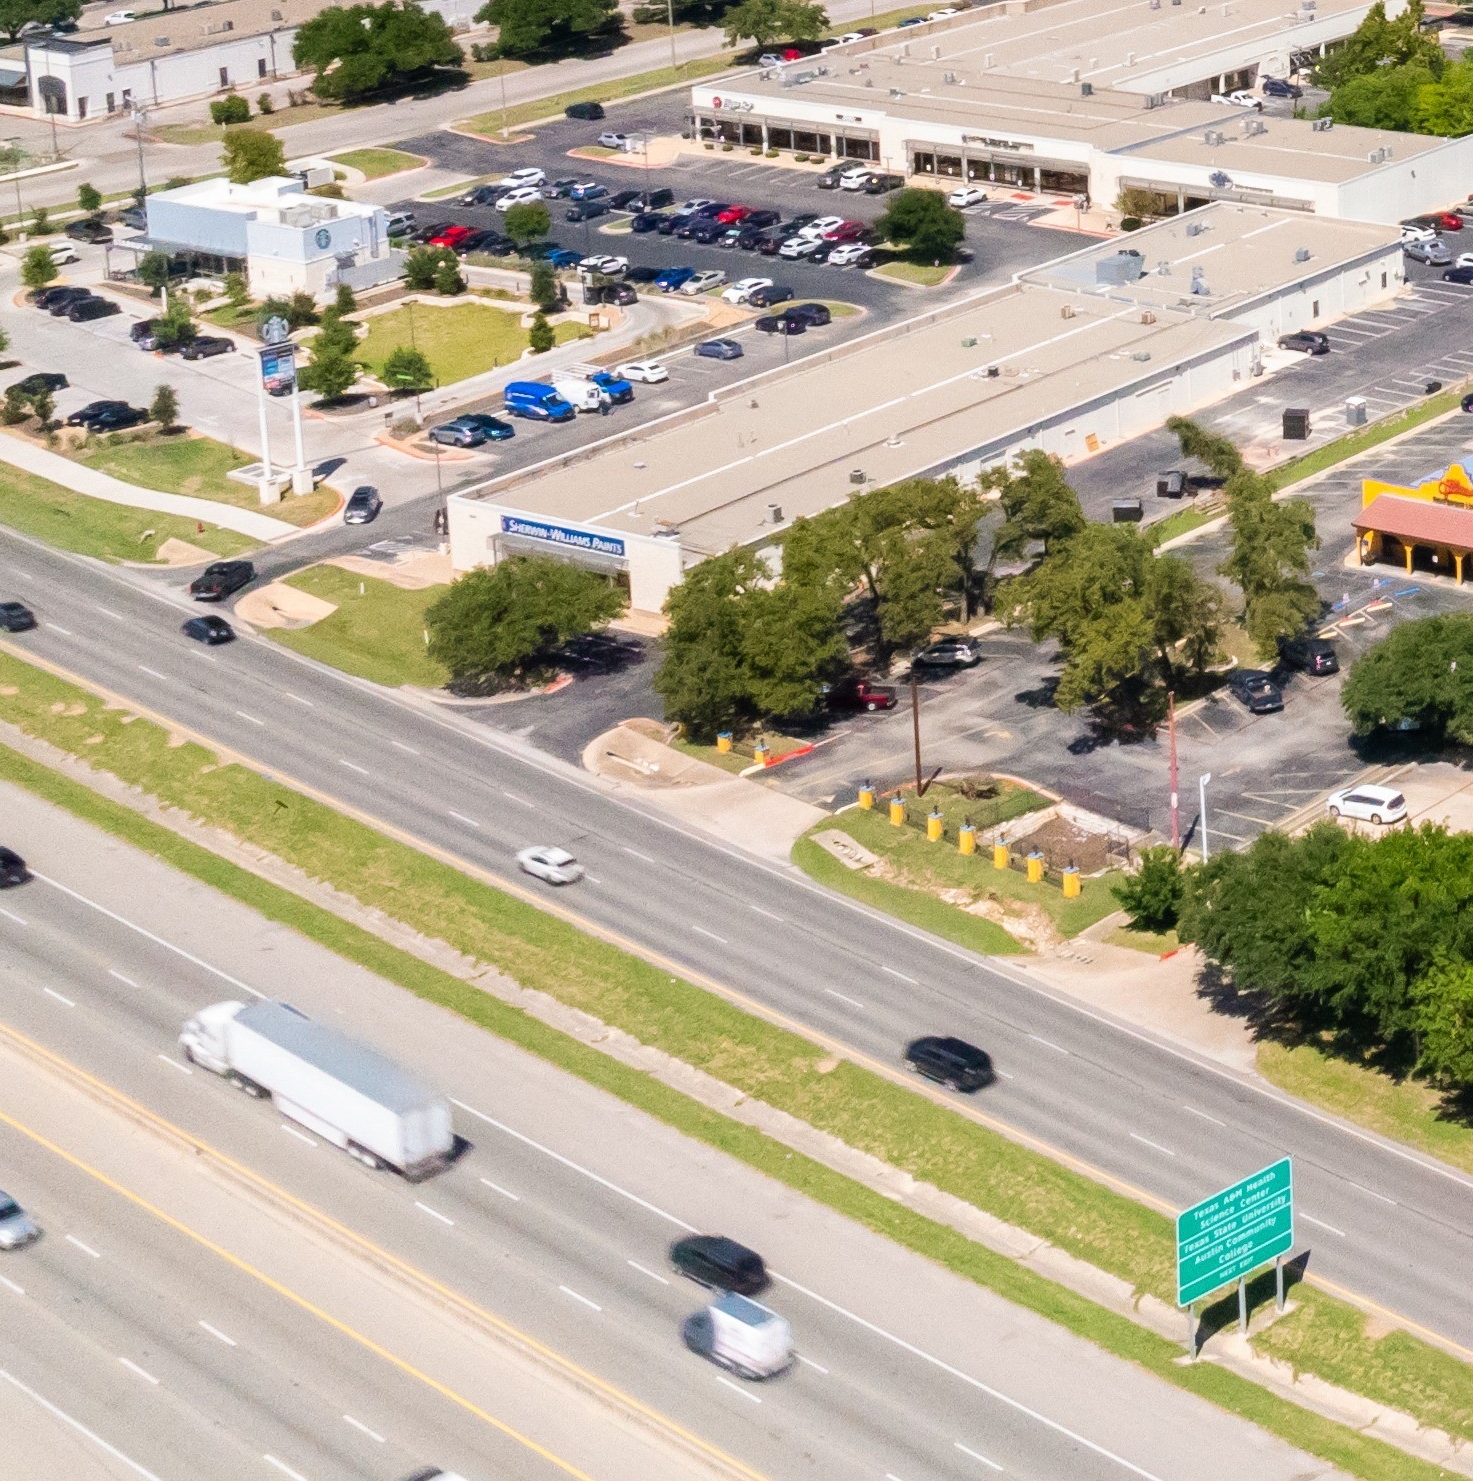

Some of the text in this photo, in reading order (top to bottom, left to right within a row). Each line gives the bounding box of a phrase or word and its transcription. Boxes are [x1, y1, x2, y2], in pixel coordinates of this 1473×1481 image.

[509, 519, 623, 554] SHERWIN-WILLIAMS PAINTS
[1194, 1172, 1276, 1220] Texas A&M Health
[1201, 1187, 1269, 1229] Science Center
[1184, 1195, 1286, 1253] Texas State University
[1195, 1217, 1277, 1265] Austin Community
[1219, 1241, 1253, 1263] College
